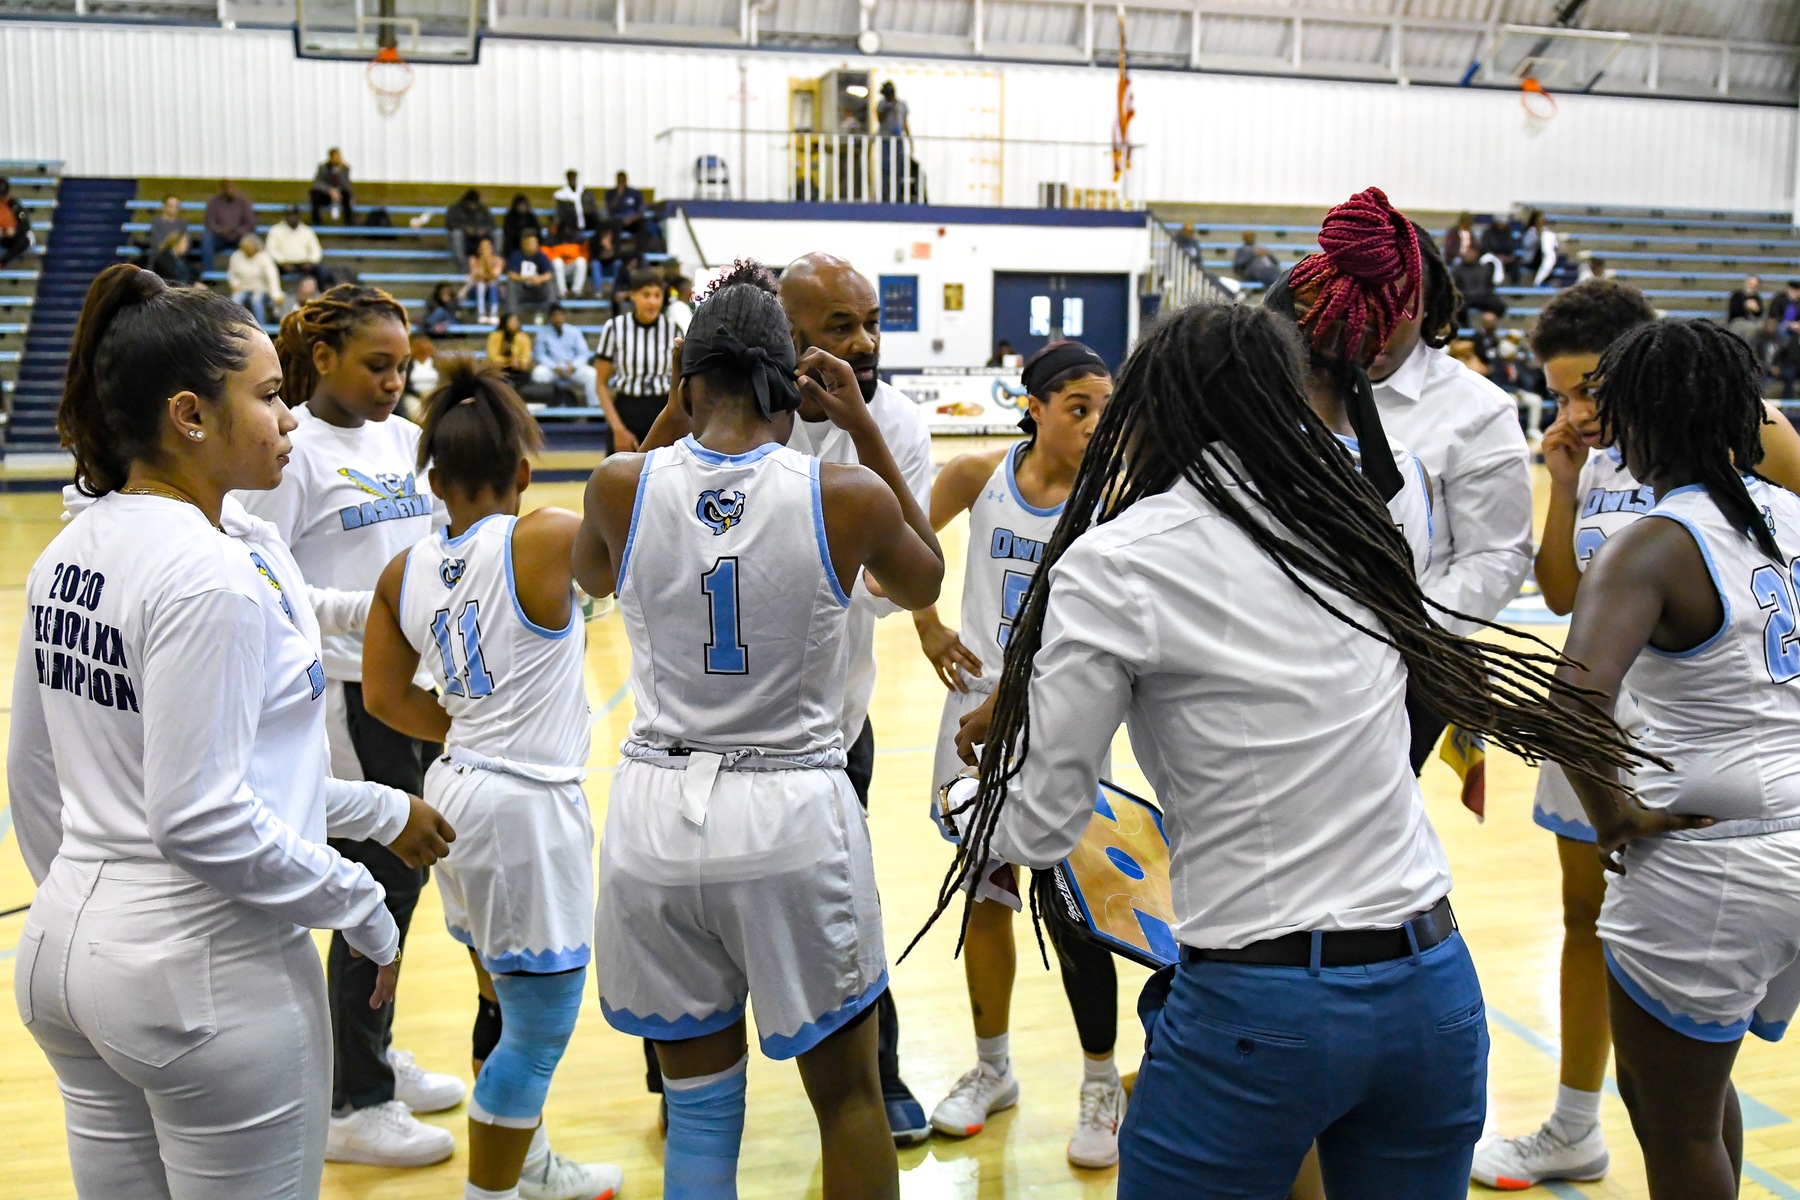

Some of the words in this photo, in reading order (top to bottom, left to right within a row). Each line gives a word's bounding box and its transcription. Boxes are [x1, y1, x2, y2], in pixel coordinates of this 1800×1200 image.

[1581, 484, 1656, 520] OWLS
[991, 527, 1046, 564] OWL
[49, 562, 105, 611] 2020
[32, 605, 90, 656] EGION
[701, 556, 749, 675] 1
[431, 600, 494, 698] 11
